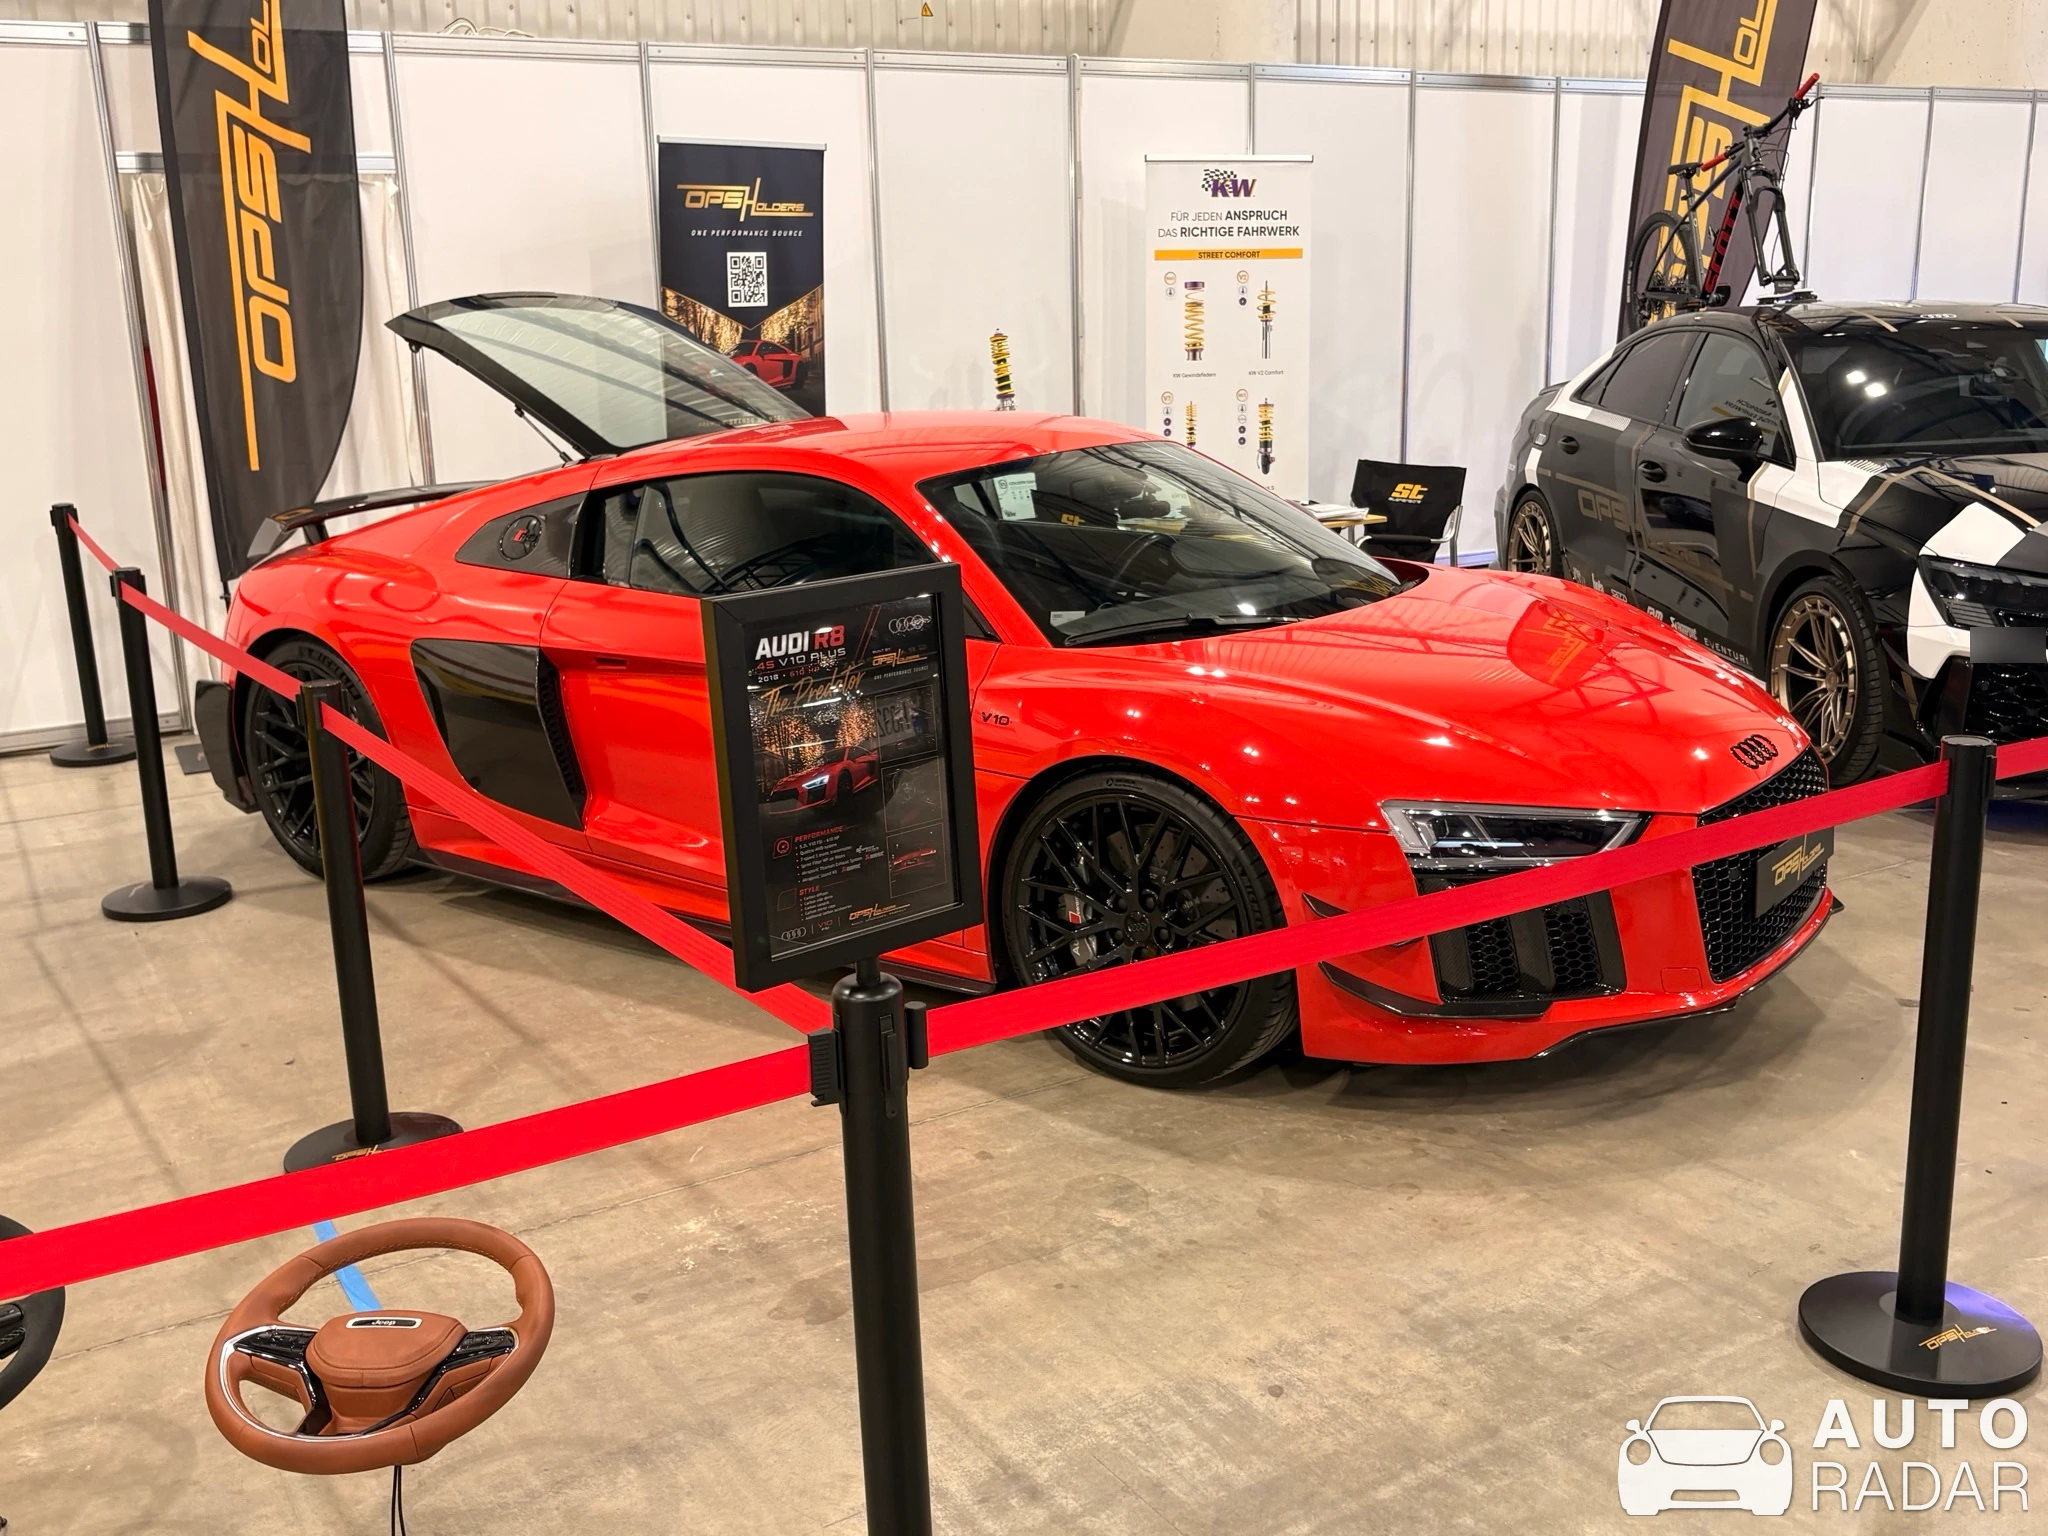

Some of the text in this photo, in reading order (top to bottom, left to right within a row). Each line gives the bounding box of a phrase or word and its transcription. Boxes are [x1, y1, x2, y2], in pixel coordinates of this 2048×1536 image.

[1211, 178, 1257, 198] KW
[1171, 210, 1288, 221] FÜR JEDEN ANSPRUCH
[187, 0, 312, 462] OPSHOL
[691, 229, 707, 237] ONE
[711, 229, 769, 237] PERFORMANCE
[1158, 226, 1300, 237] DAS RICHTIGE FAHRWERK
[1705, 190, 1741, 293] SCOTT
[1198, 250, 1260, 259] STREET COMFORT
[754, 624, 845, 661] AUDI R8
[1703, 637, 1750, 665] EVENTURI
[756, 660, 775, 670] 4S
[779, 655, 806, 666] V10
[760, 662, 866, 723] The Predator
[981, 711, 1010, 726] V10
[795, 825, 843, 843] PERFORMANCE
[799, 885, 820, 896] STYLE
[371, 1319, 396, 1327] Jeep
